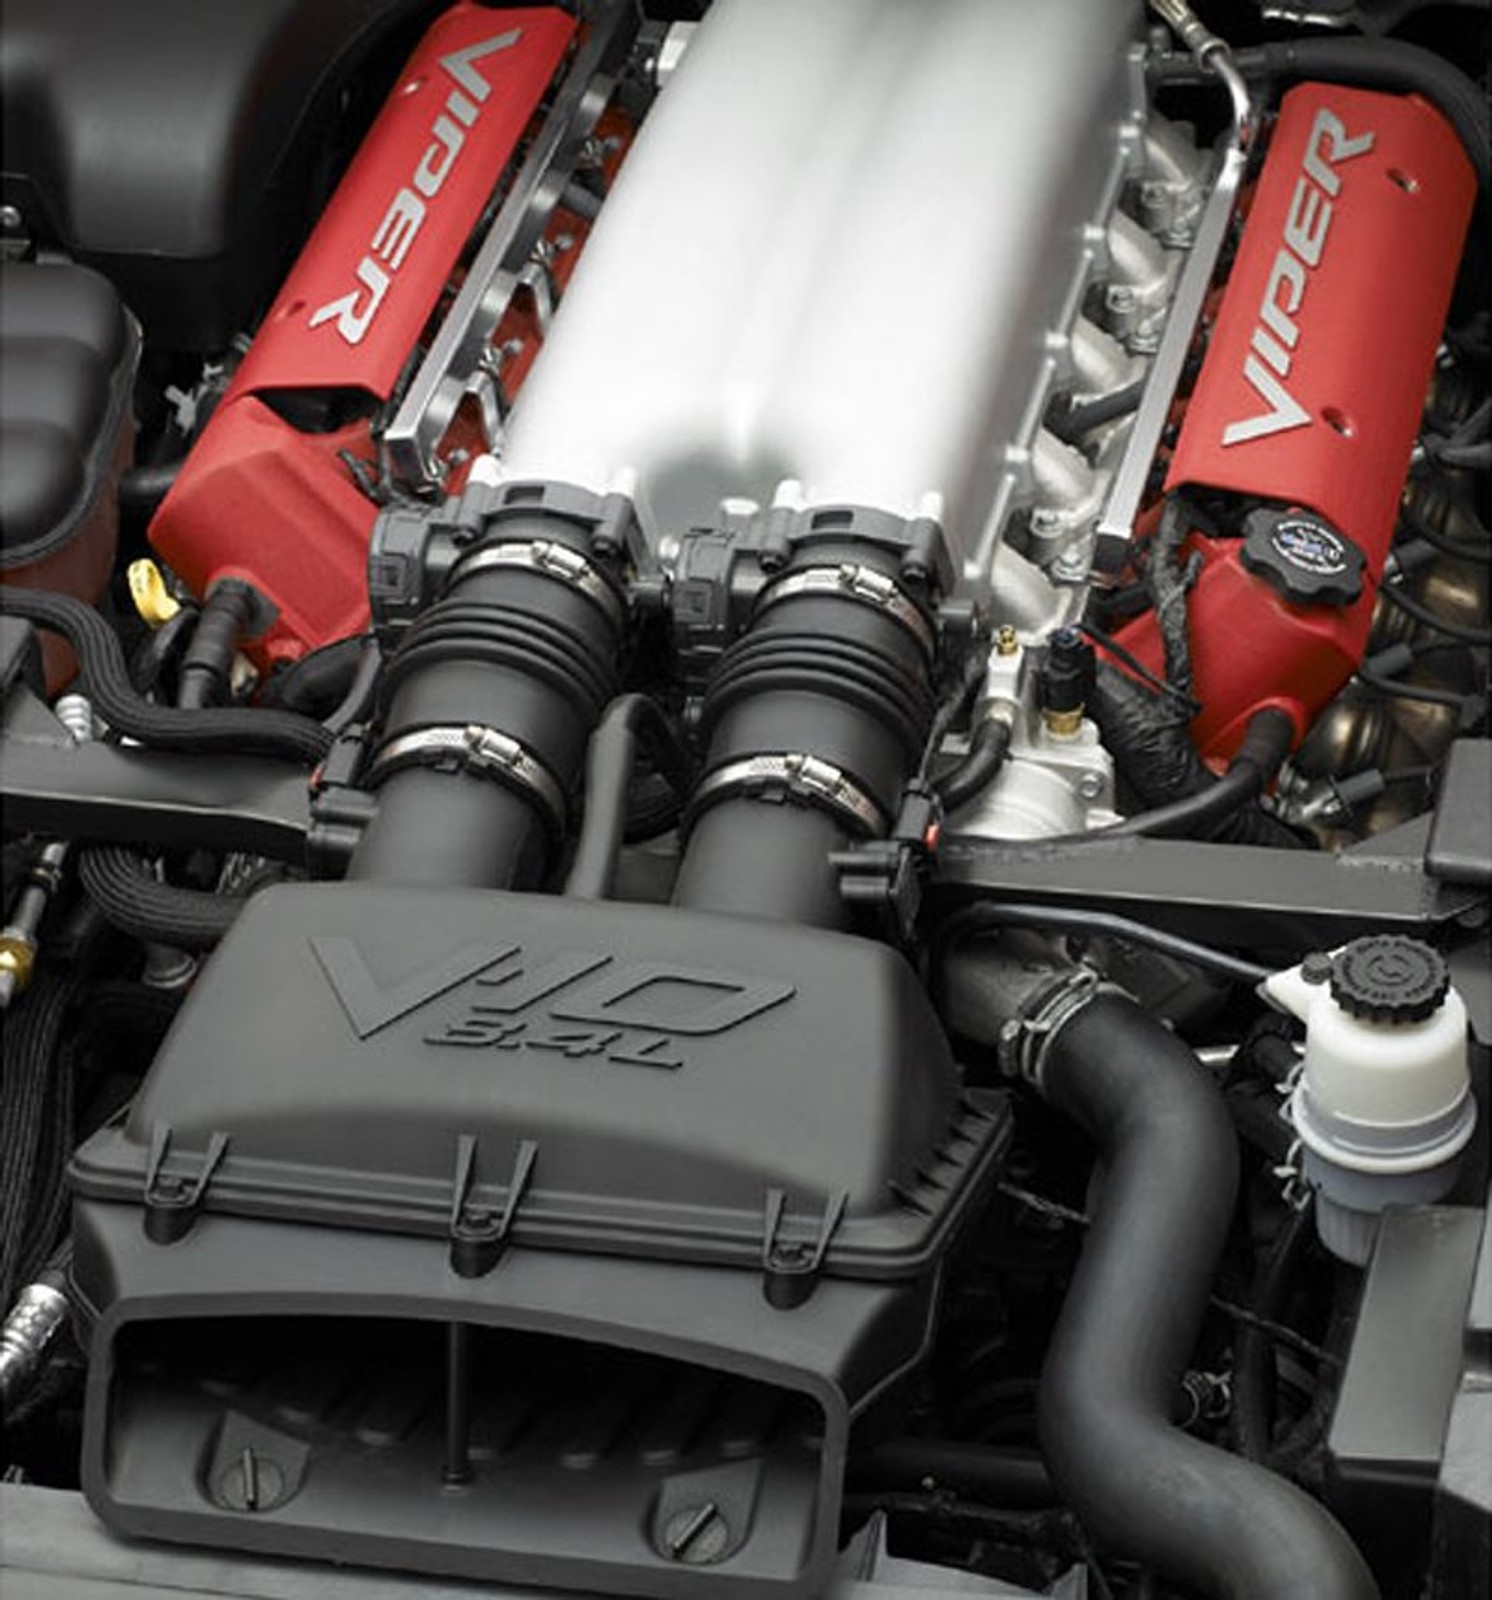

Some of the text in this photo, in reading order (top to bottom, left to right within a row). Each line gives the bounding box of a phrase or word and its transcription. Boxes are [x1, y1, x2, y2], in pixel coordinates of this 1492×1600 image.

[308, 28, 522, 344] VIPER
[1221, 107, 1376, 447] VIPER
[307, 935, 797, 1040] V10
